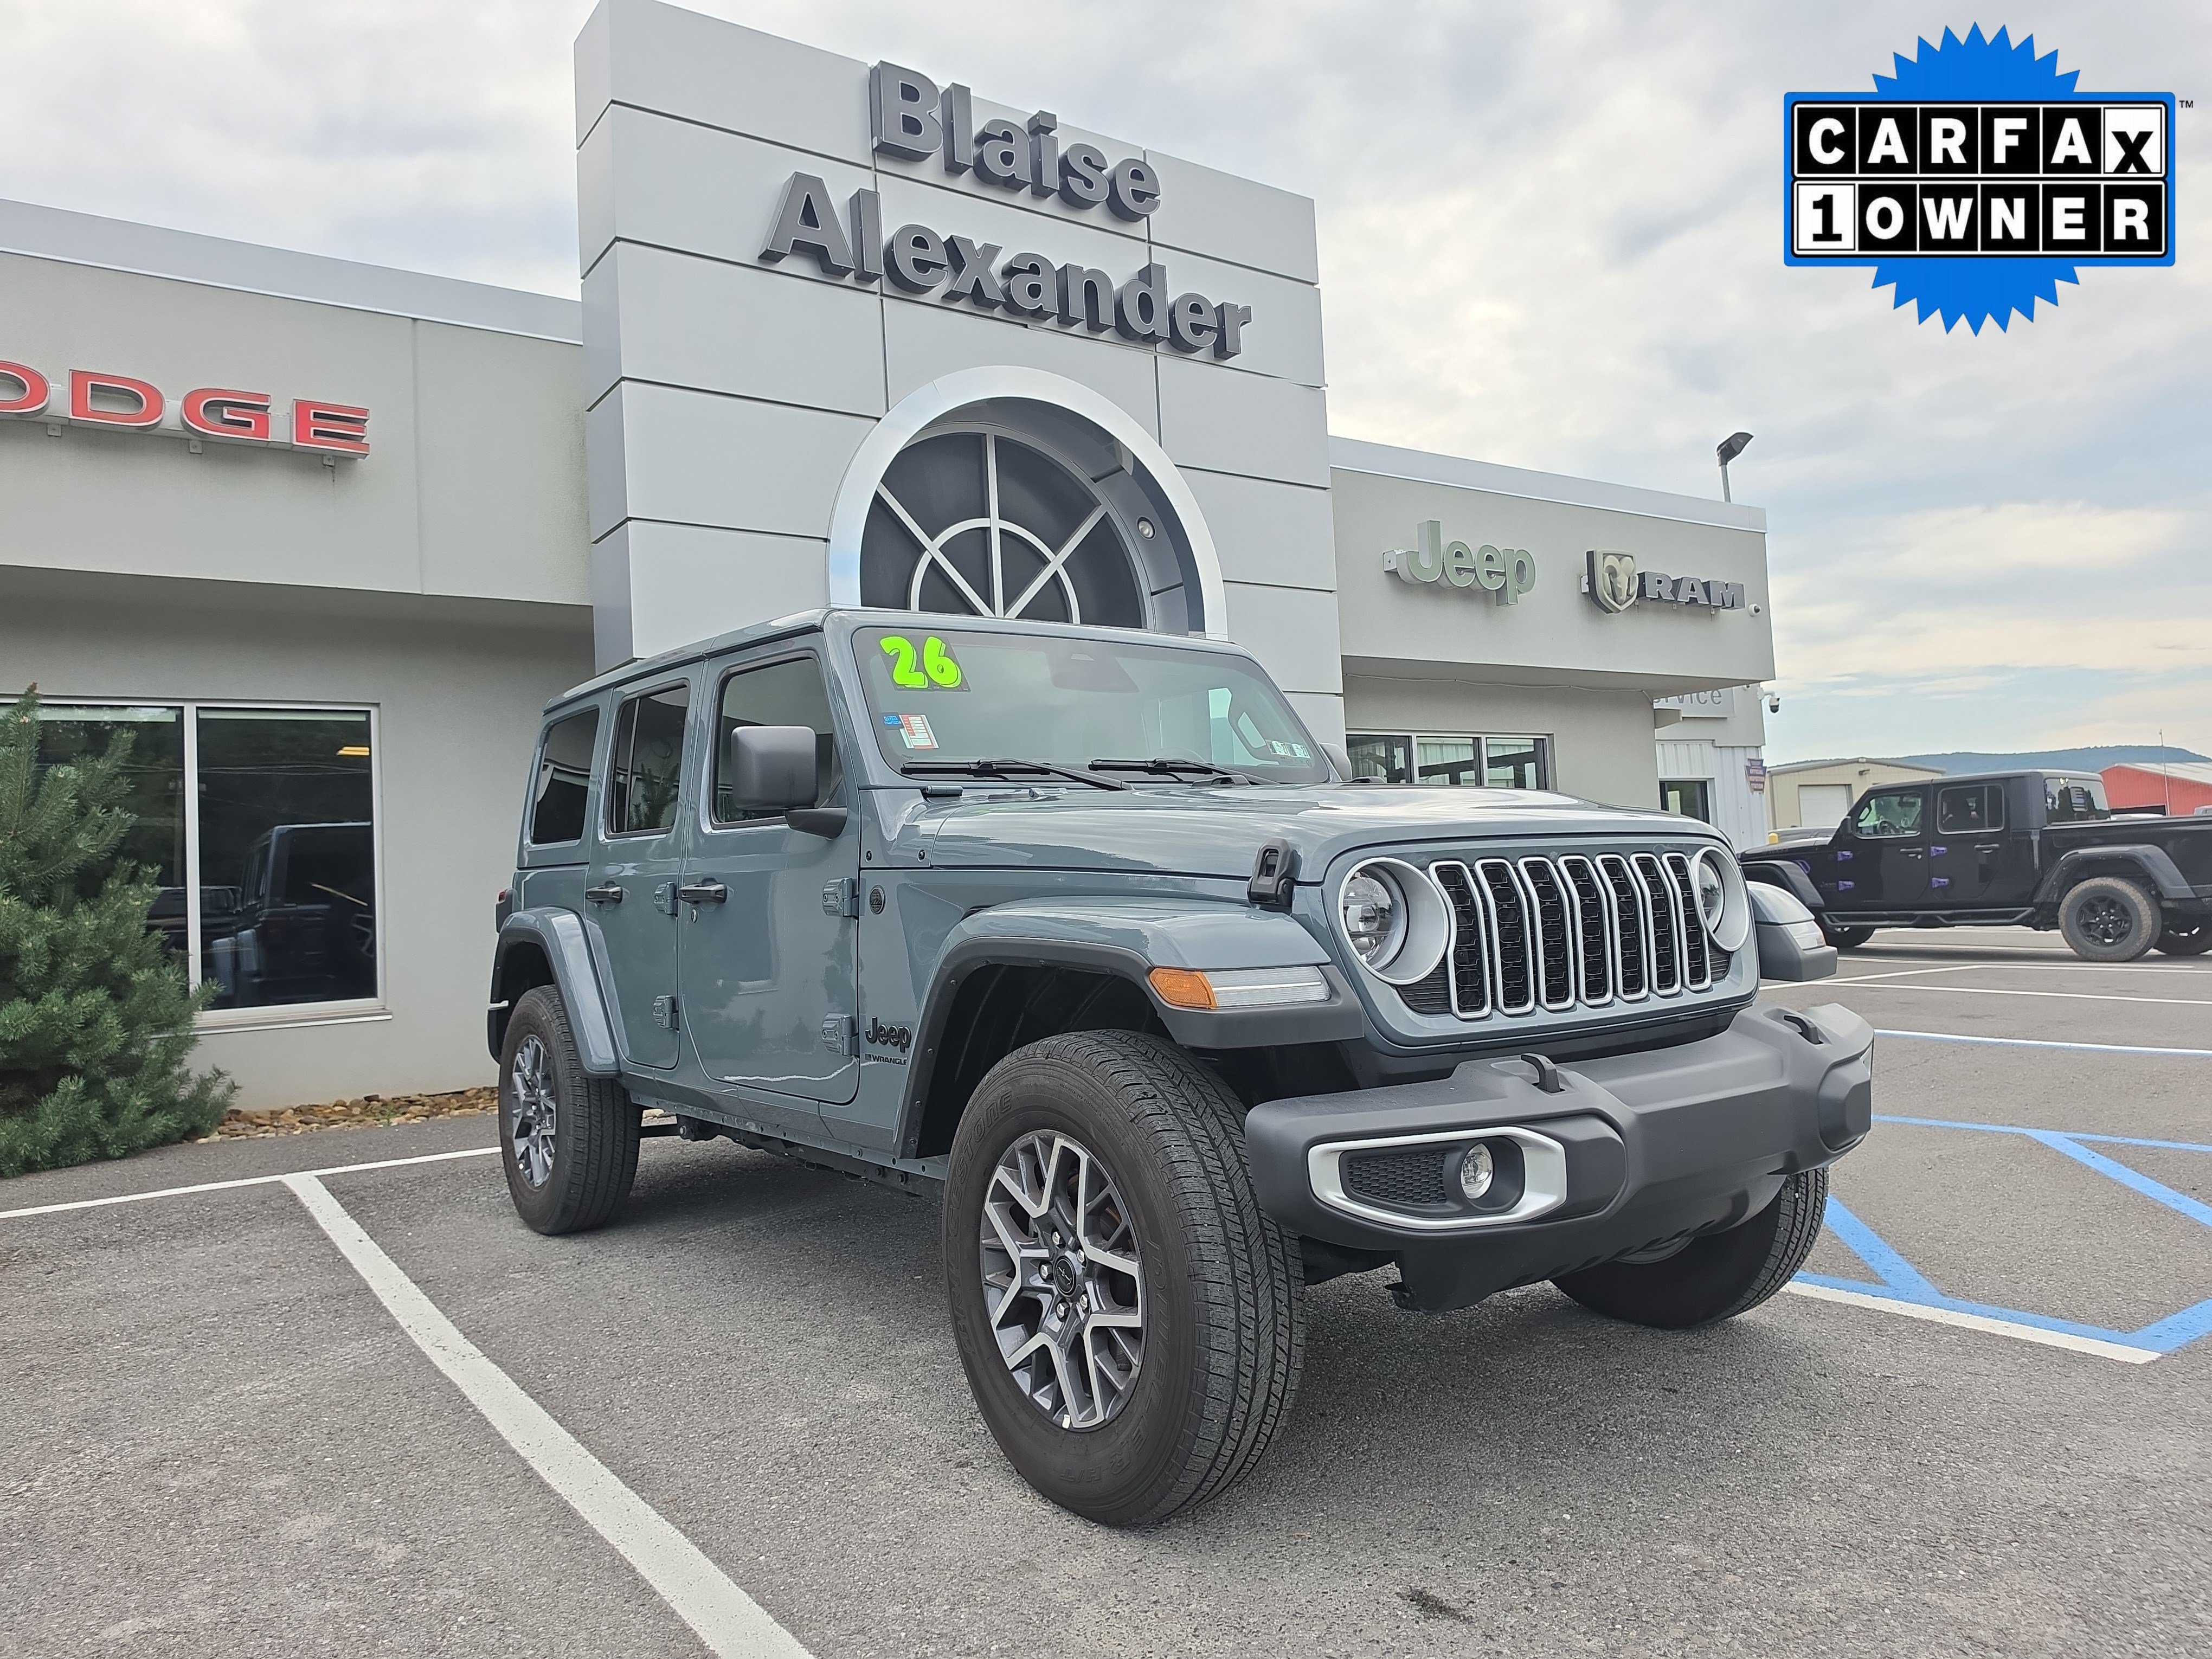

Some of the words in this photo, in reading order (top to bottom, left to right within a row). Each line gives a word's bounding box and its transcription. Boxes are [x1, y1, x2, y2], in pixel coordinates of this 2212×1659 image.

[870, 60, 1161, 222] Blaise
[758, 172, 1251, 360] Alexander
[1398, 520, 1536, 606] Jeep
[1638, 571, 1745, 610] RAM
[880, 635, 962, 689] 26
[865, 1017, 912, 1053] Jeep
[947, 1091, 1013, 1354] BRIDGESTONE
